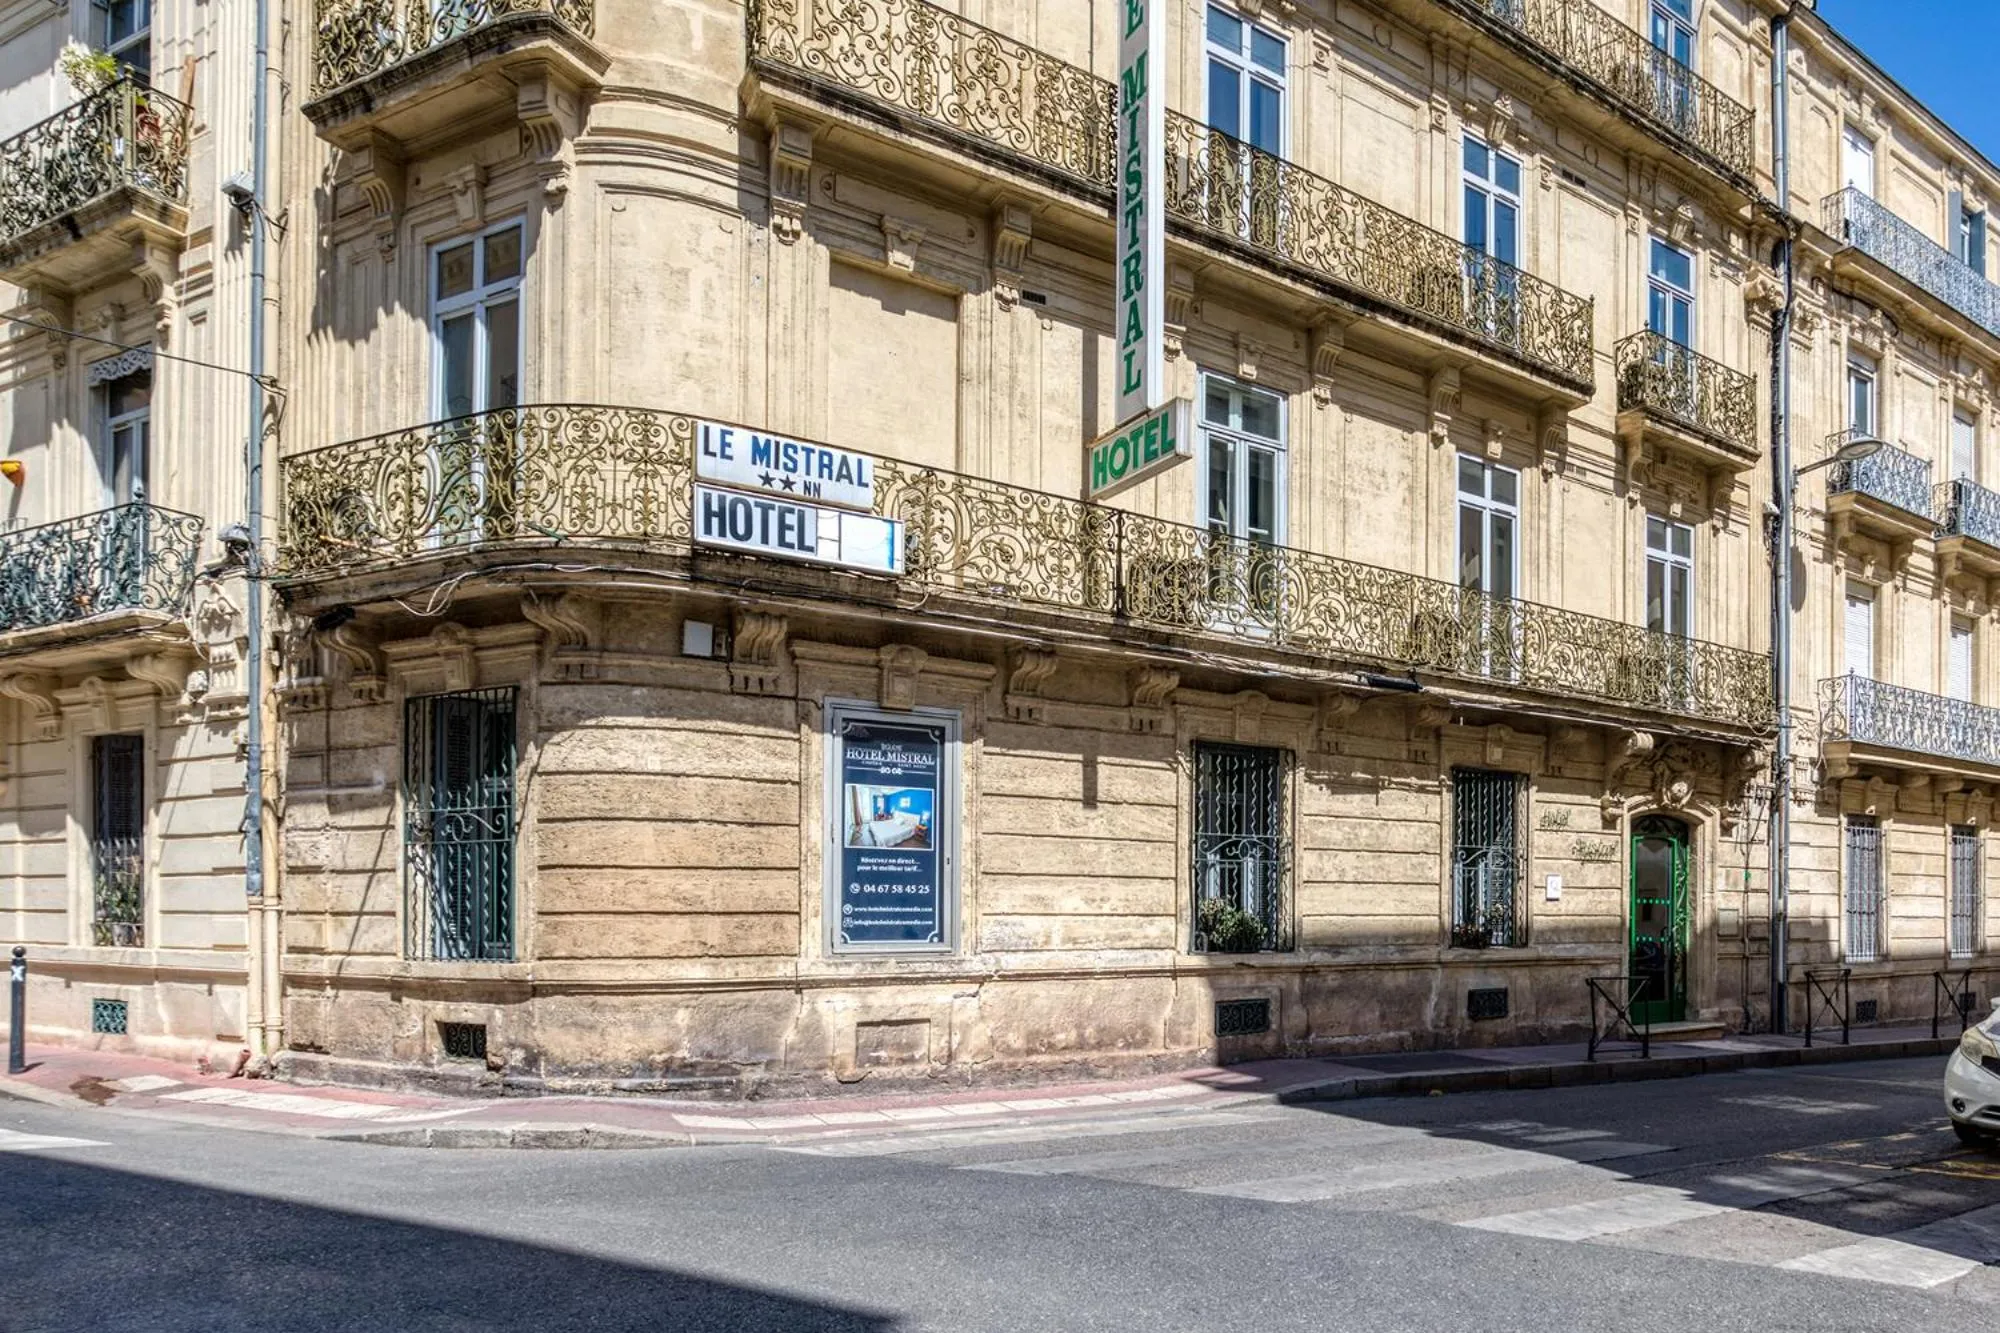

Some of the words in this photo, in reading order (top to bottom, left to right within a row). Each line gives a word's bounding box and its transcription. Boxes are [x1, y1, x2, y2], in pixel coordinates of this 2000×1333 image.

[1120, 48, 1148, 397] MISTRAL
[703, 425, 733, 461] LE
[751, 435, 869, 488] MISTRAL
[1092, 411, 1176, 490] HOTEL
[803, 480, 821, 499] NN
[703, 492, 815, 553] HOTEL
[887, 751, 935, 765] MISTRAL
[863, 884, 876, 893] 04
[877, 884, 890, 893] 67
[891, 885, 903, 894] 58
[905, 885, 917, 894] 45
[918, 885, 930, 894] 25
